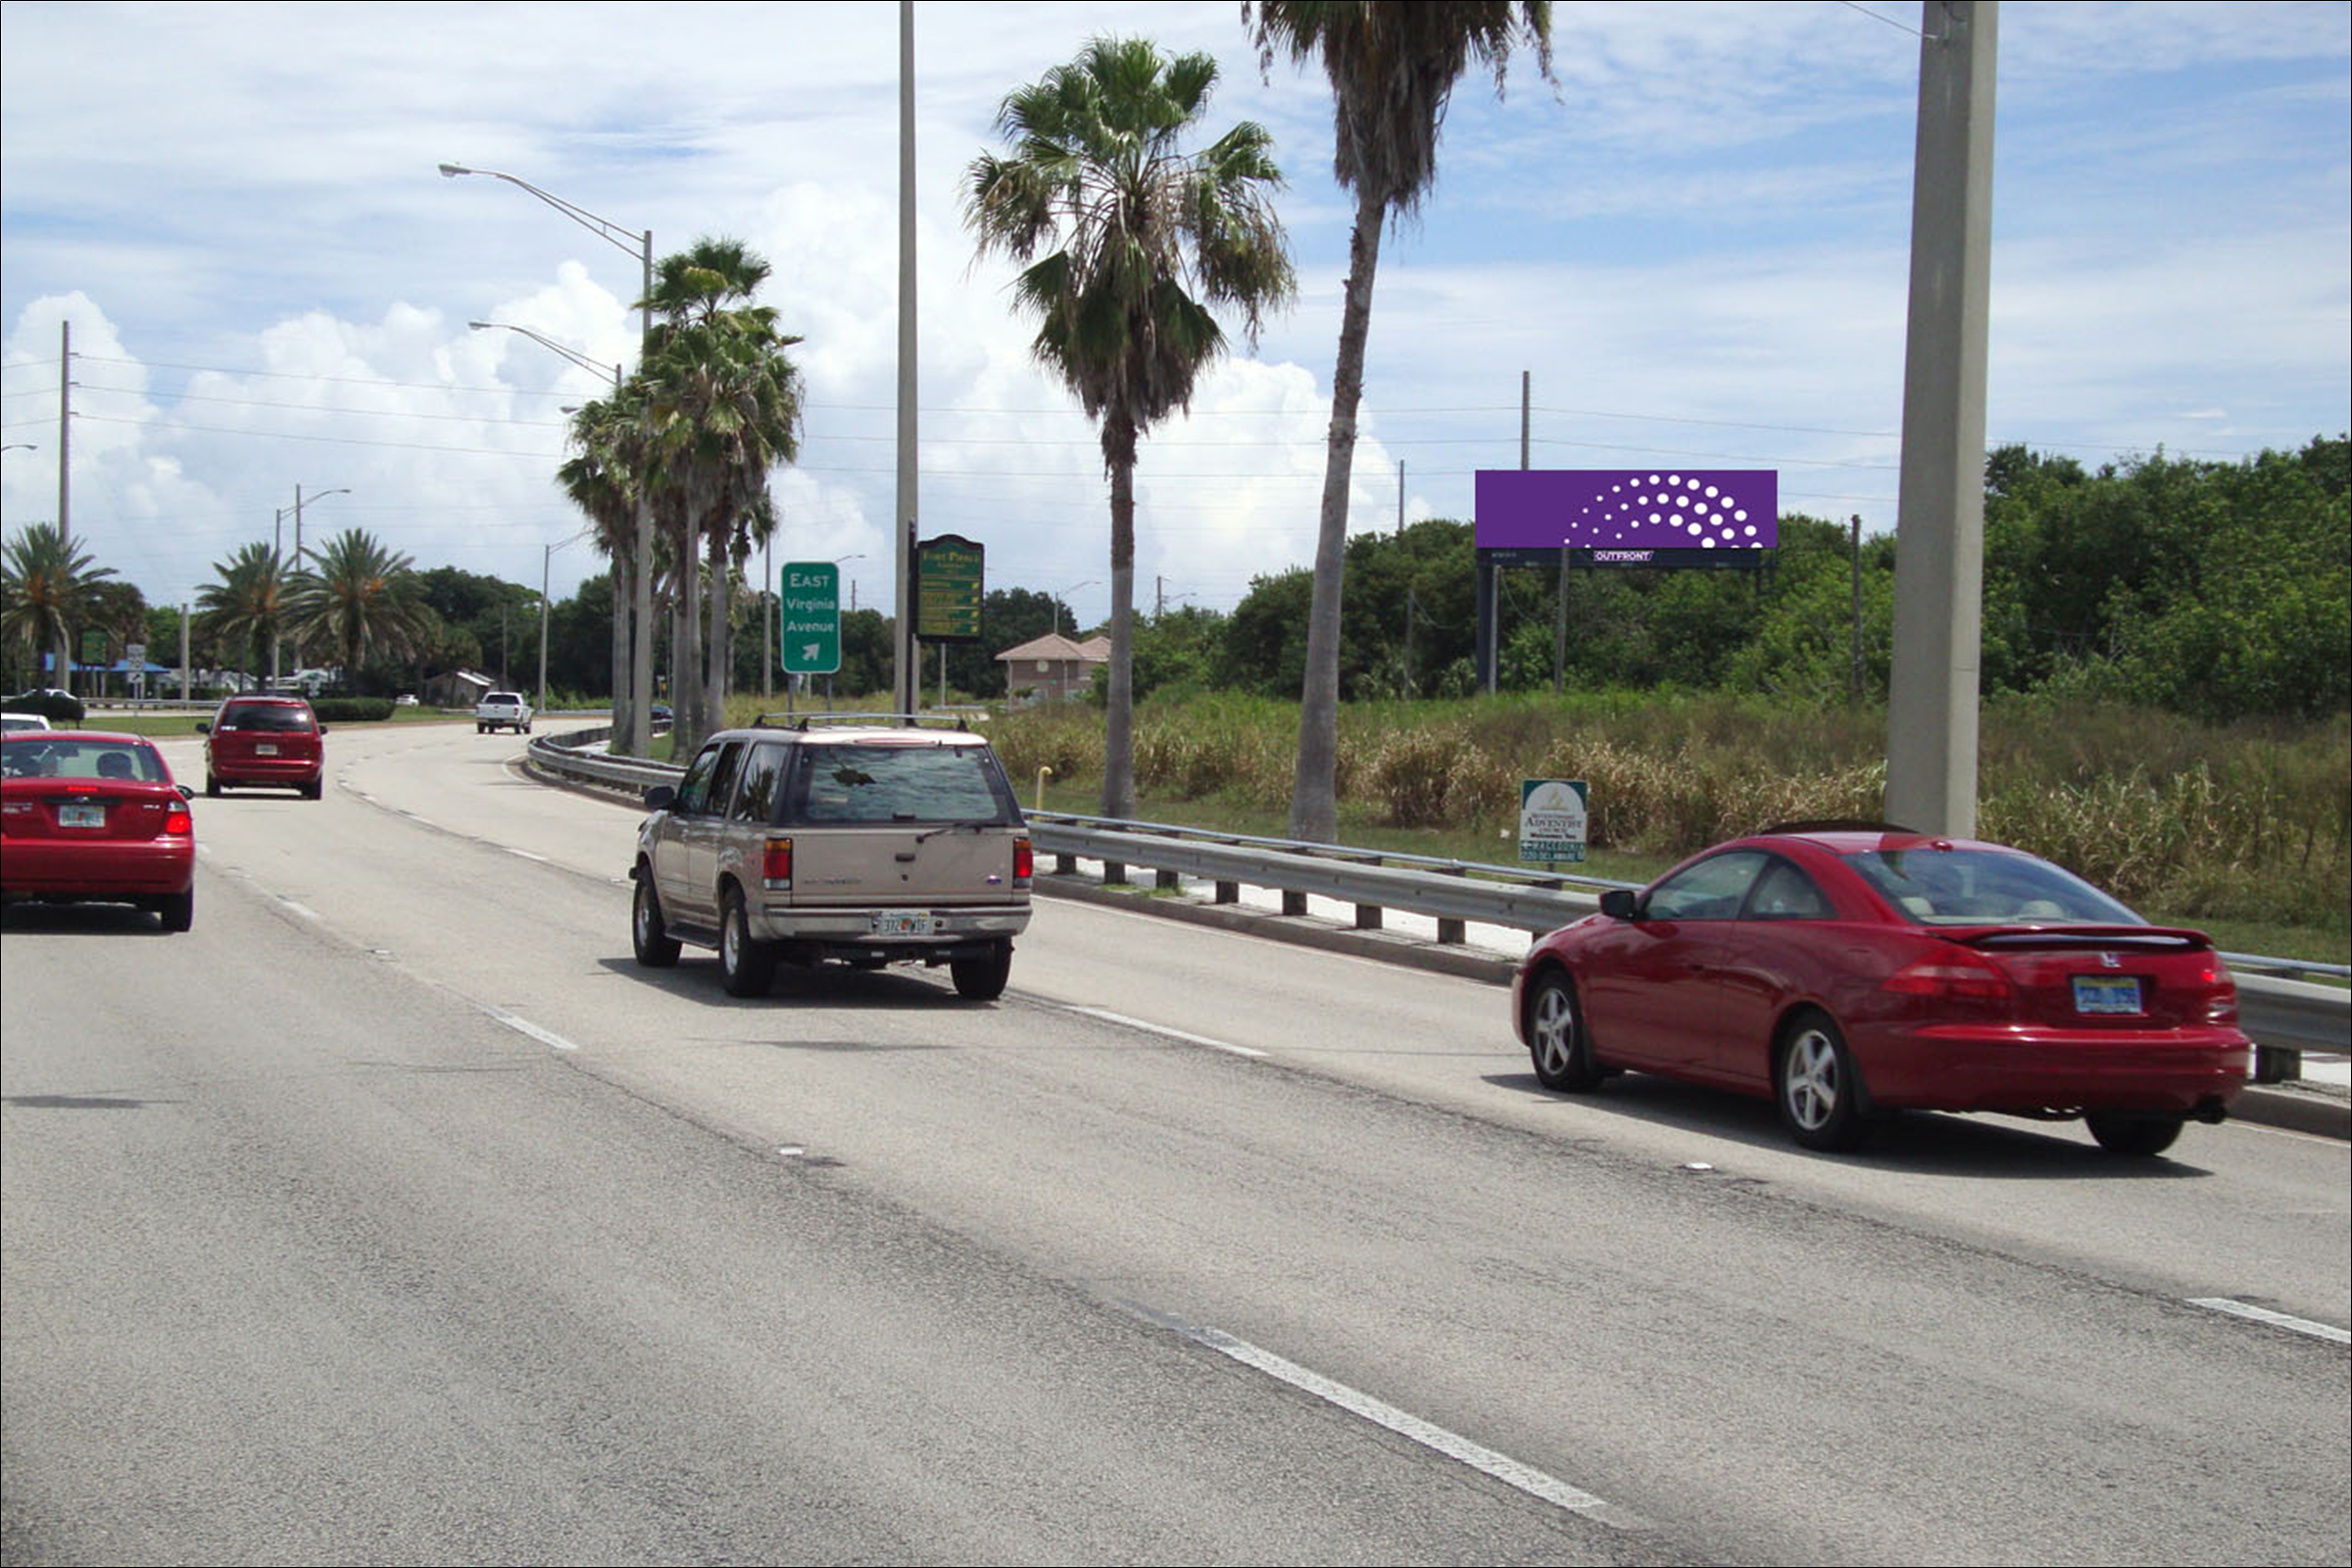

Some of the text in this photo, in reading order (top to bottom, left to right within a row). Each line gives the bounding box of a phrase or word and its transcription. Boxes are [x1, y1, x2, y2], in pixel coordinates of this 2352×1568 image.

[1595, 551, 1651, 562] OUTFRONT
[790, 572, 830, 588] EAST
[786, 597, 836, 613] Virginia
[786, 620, 835, 632] Avenue
